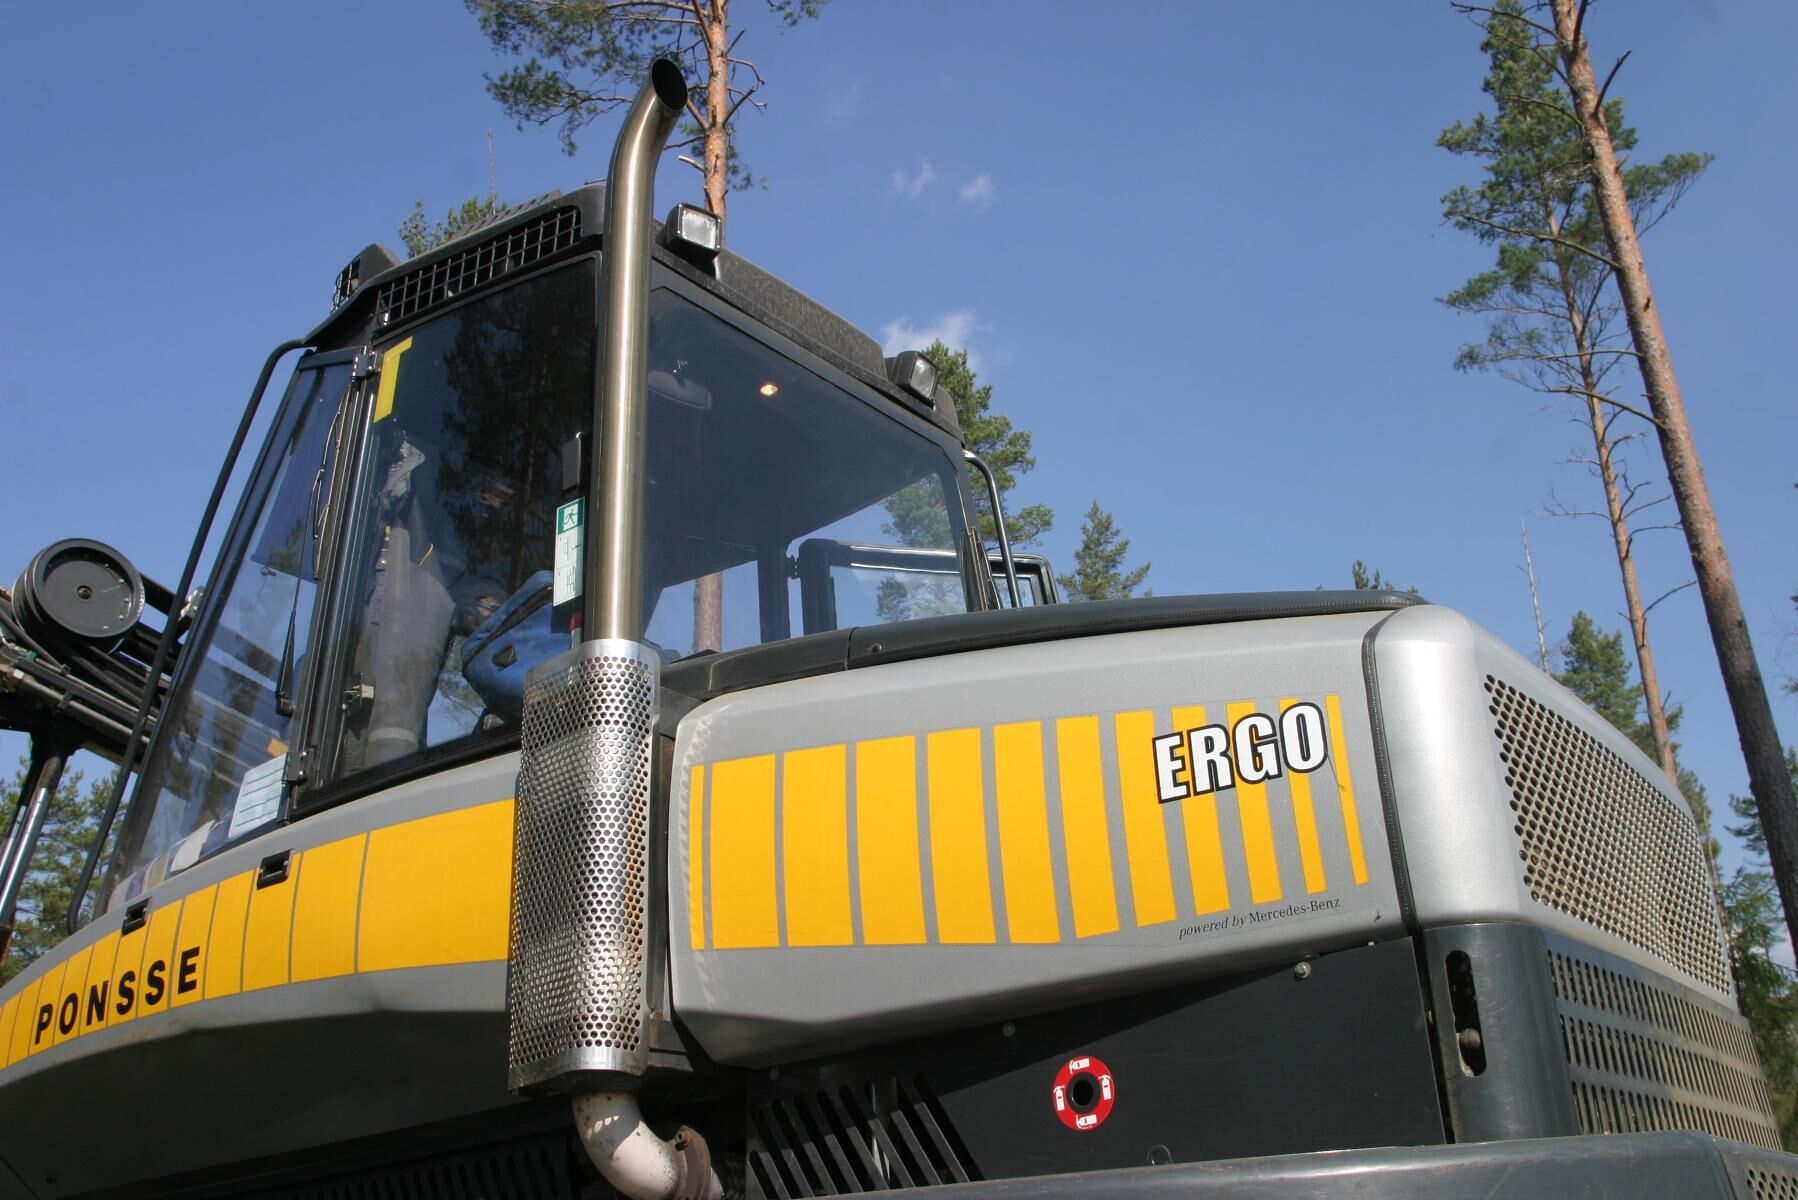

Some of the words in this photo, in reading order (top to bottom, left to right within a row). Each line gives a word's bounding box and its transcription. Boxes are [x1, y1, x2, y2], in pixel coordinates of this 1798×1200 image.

[1152, 702, 1328, 804] ERGO
[1178, 917, 1230, 940] powered
[1231, 912, 1247, 929] by
[1249, 898, 1341, 923] Mercedes-Benz
[34, 946, 200, 1045] PONSSE
